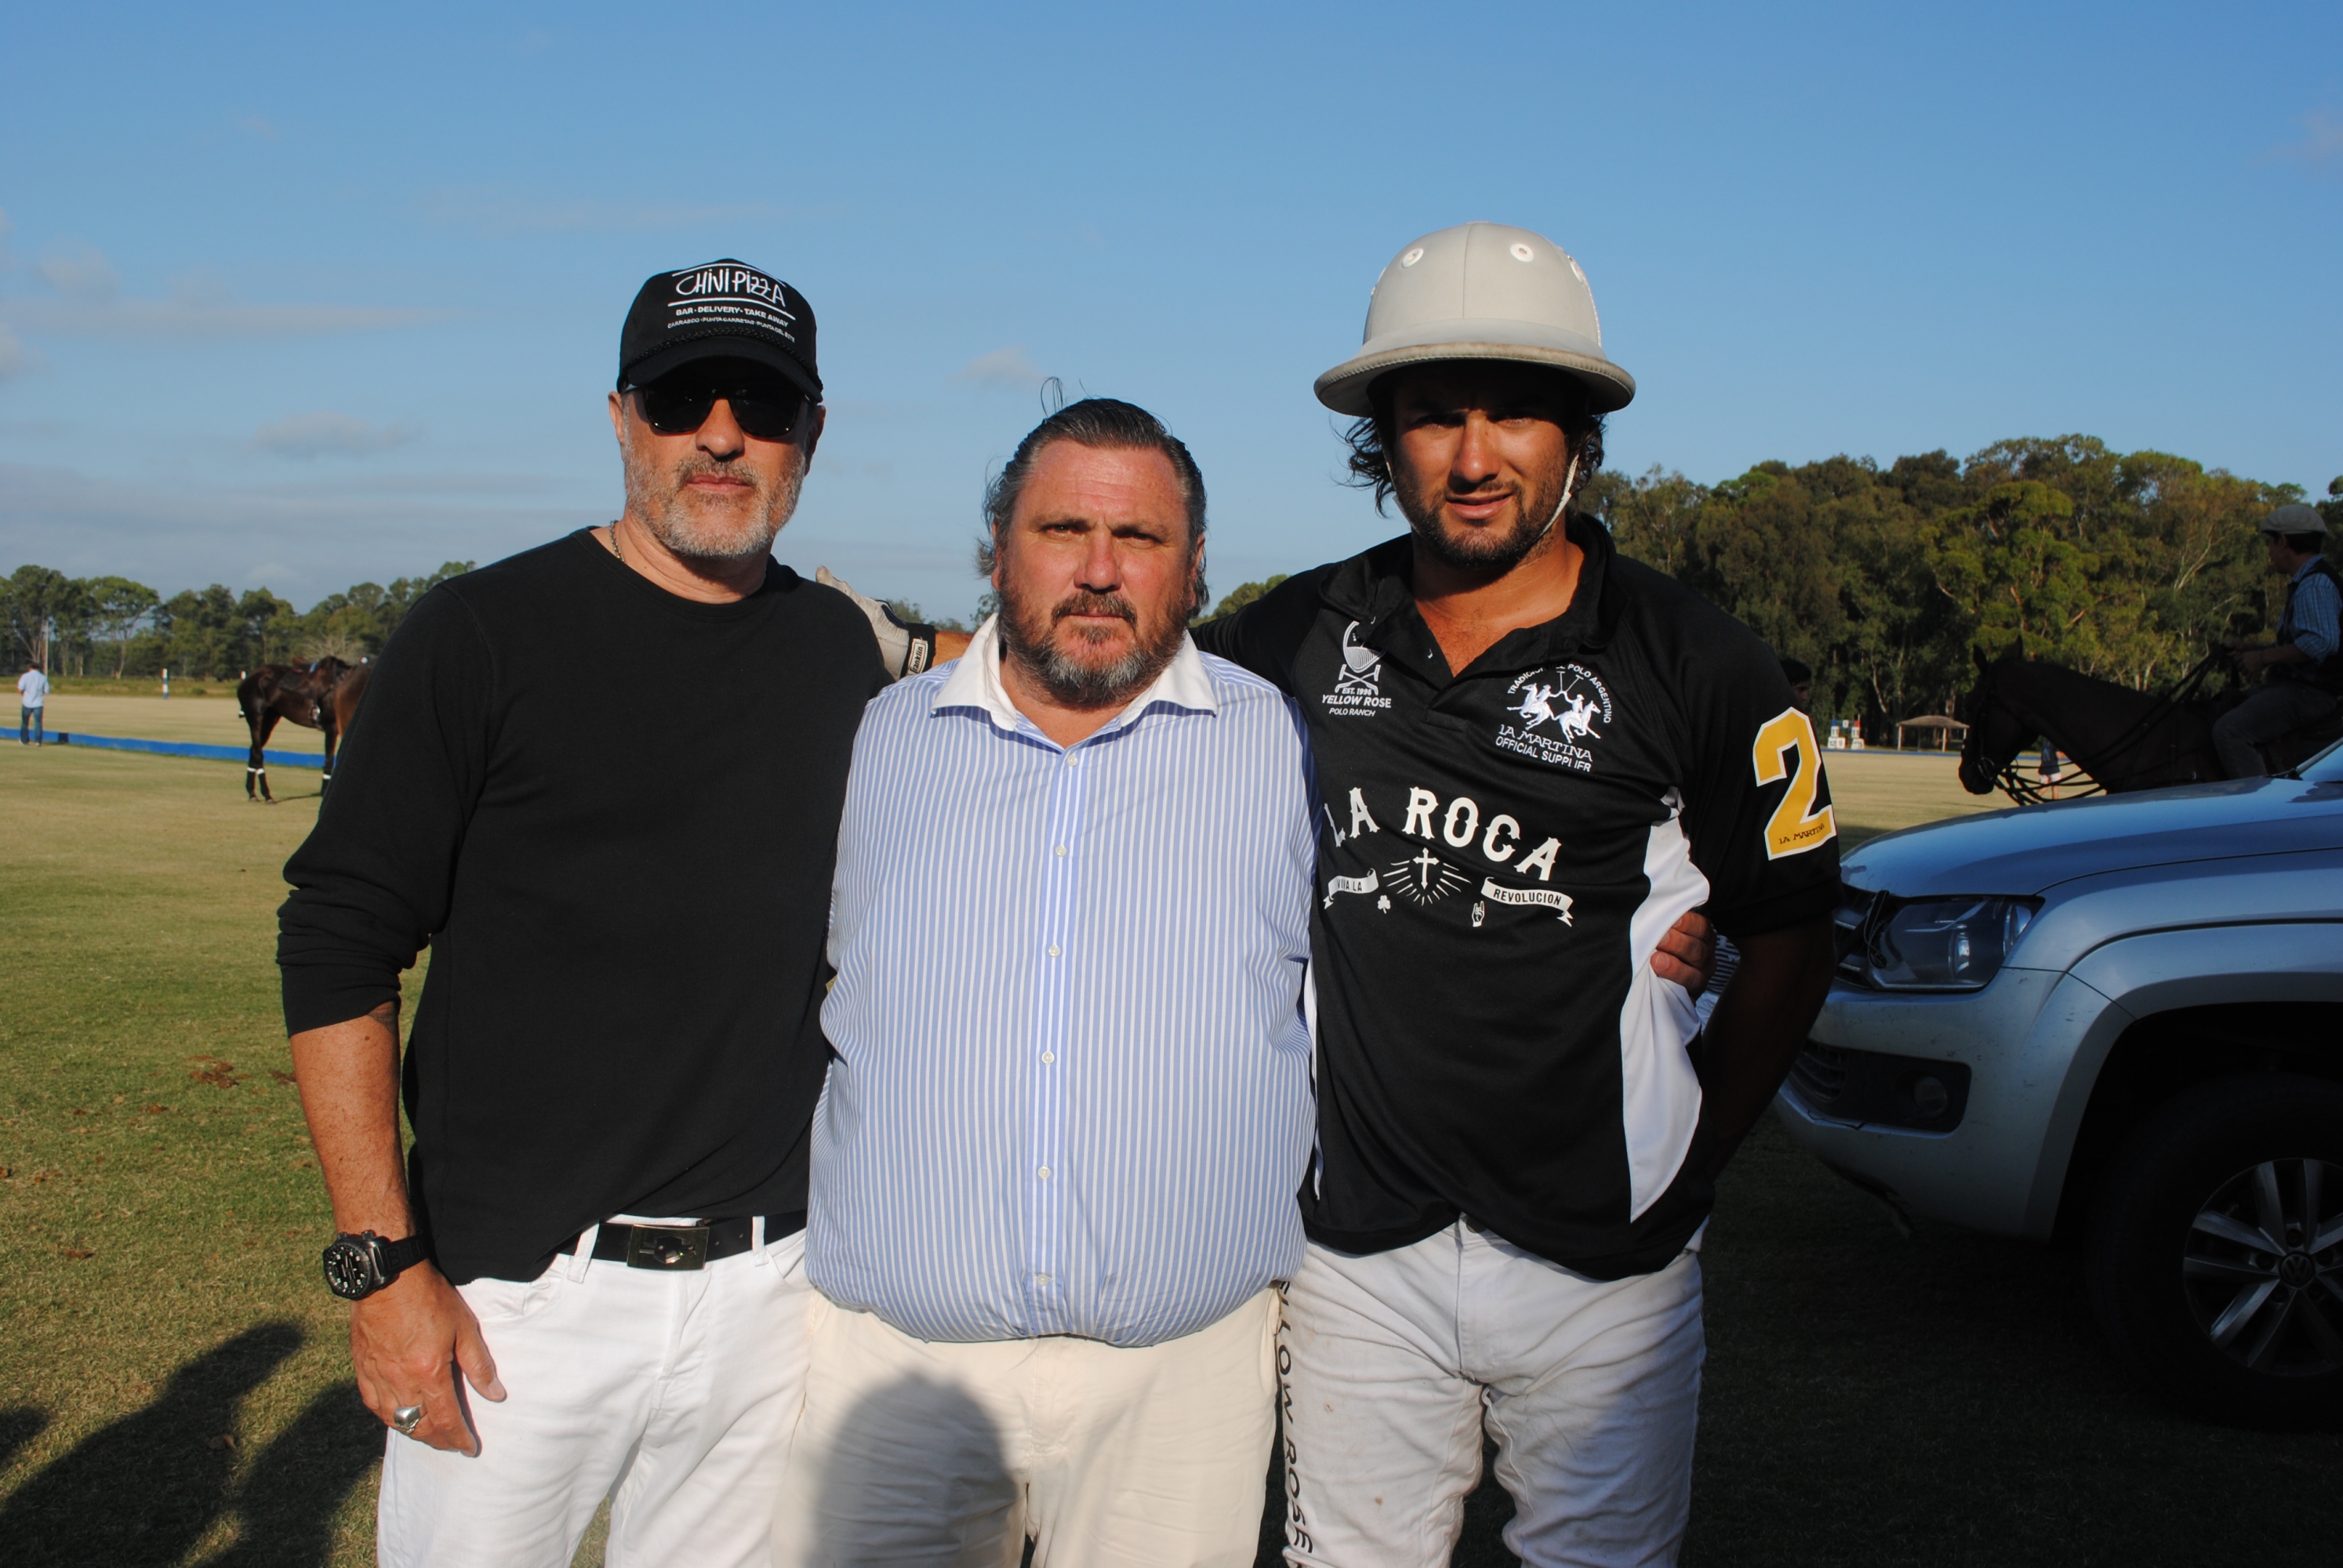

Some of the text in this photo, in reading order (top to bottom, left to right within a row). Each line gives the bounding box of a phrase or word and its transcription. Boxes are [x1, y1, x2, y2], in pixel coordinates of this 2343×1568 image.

[676, 307, 693, 316] BAR
[743, 307, 766, 318] TAKE
[767, 314, 789, 327] AWAY
[1321, 695, 1391, 708] YELLOW ROSE
[1567, 663, 1592, 678] POLO
[1589, 676, 1613, 724] ARGENTINO
[1329, 707, 1376, 717] POLO RANCH
[1495, 736, 1538, 758] OFFICIAL
[1498, 724, 1593, 762] LA MARTINA
[1753, 706, 1836, 861] 2
[1324, 786, 1562, 881] LA ROCA
[1337, 878, 1362, 891] VIVA LA
[1493, 887, 1562, 906] REVOLUCION
[1284, 1435, 1313, 1553] ROSE
